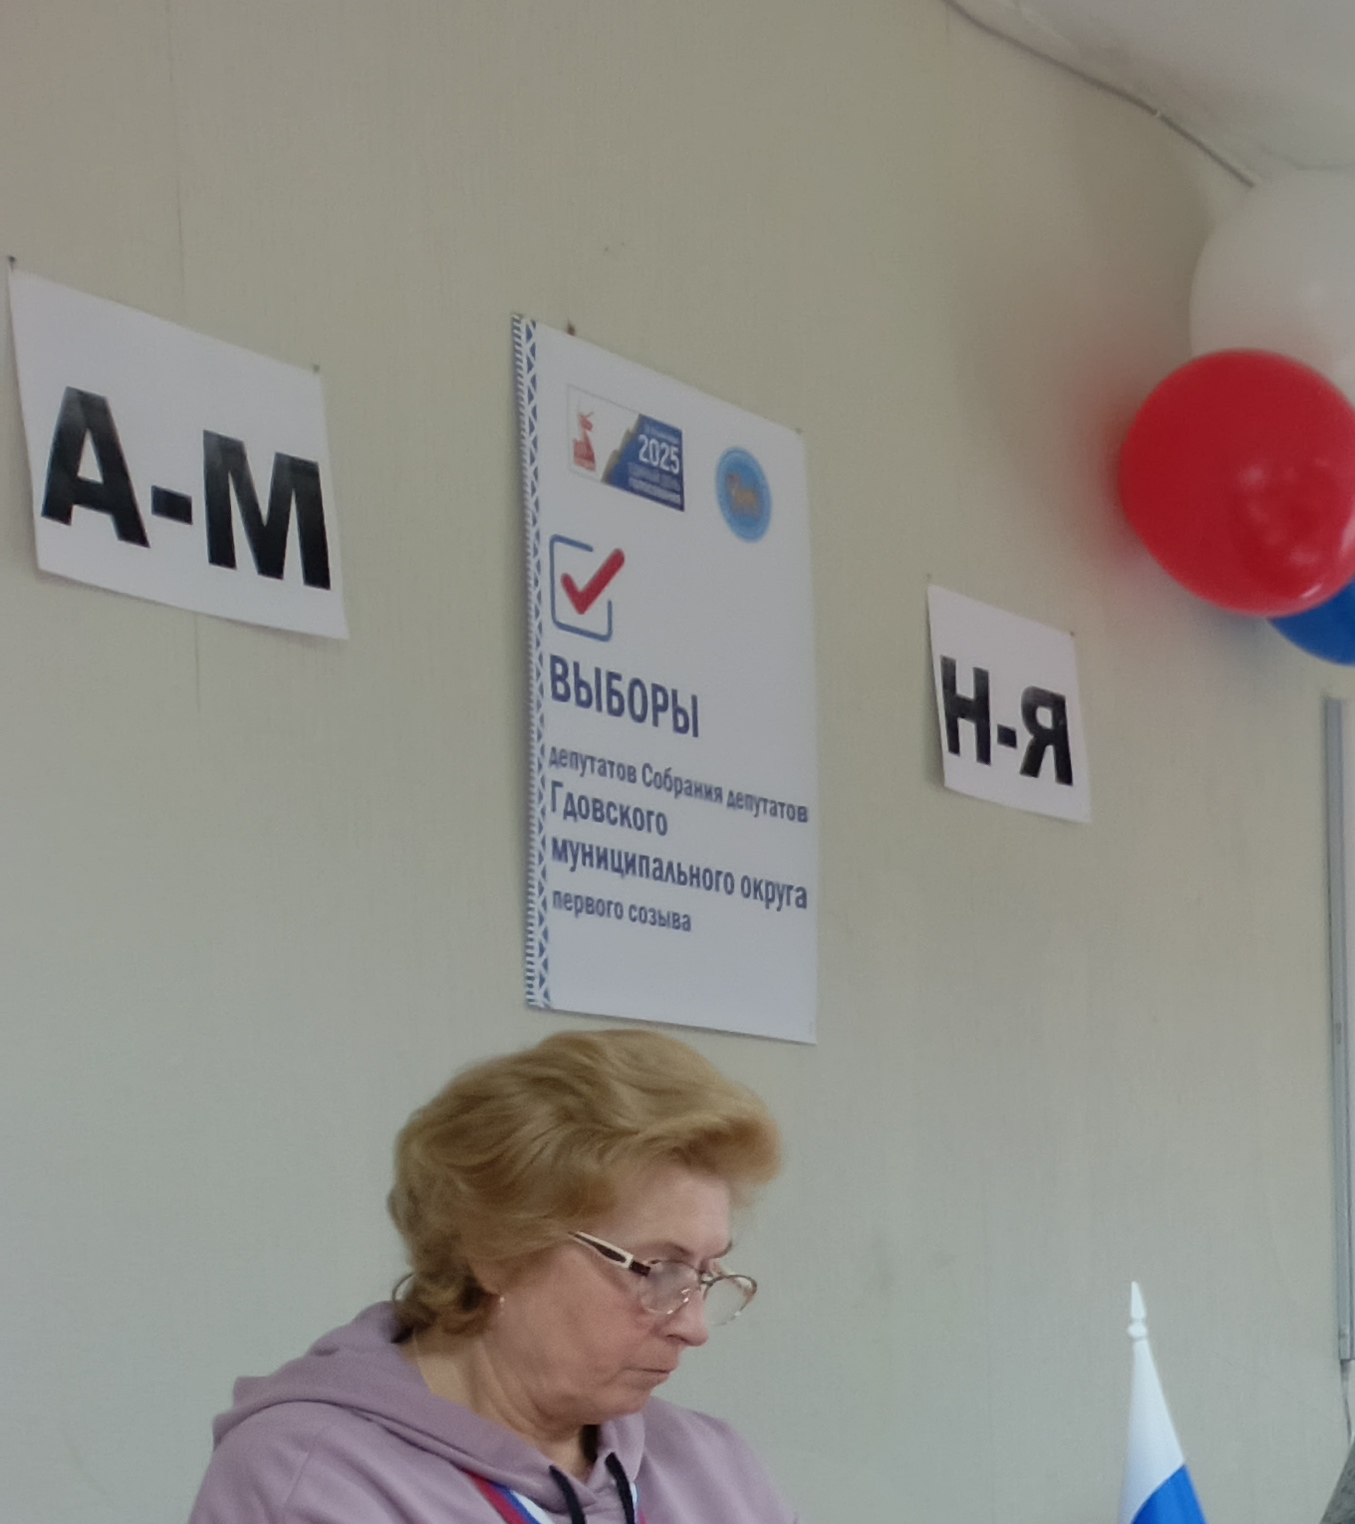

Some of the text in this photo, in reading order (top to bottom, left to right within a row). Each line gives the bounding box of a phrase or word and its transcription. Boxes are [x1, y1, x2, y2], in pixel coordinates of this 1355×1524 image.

[41, 386, 331, 591] А-М
[638, 433, 679, 475] 2025
[550, 654, 699, 738] ВЫБОРЫ
[940, 654, 1073, 787] Н-Я
[549, 746, 809, 823] депутатов Собрания депутатов
[551, 780, 668, 837] Гдовского
[551, 836, 808, 912] муниципального округа
[552, 889, 692, 932] первого созыва
